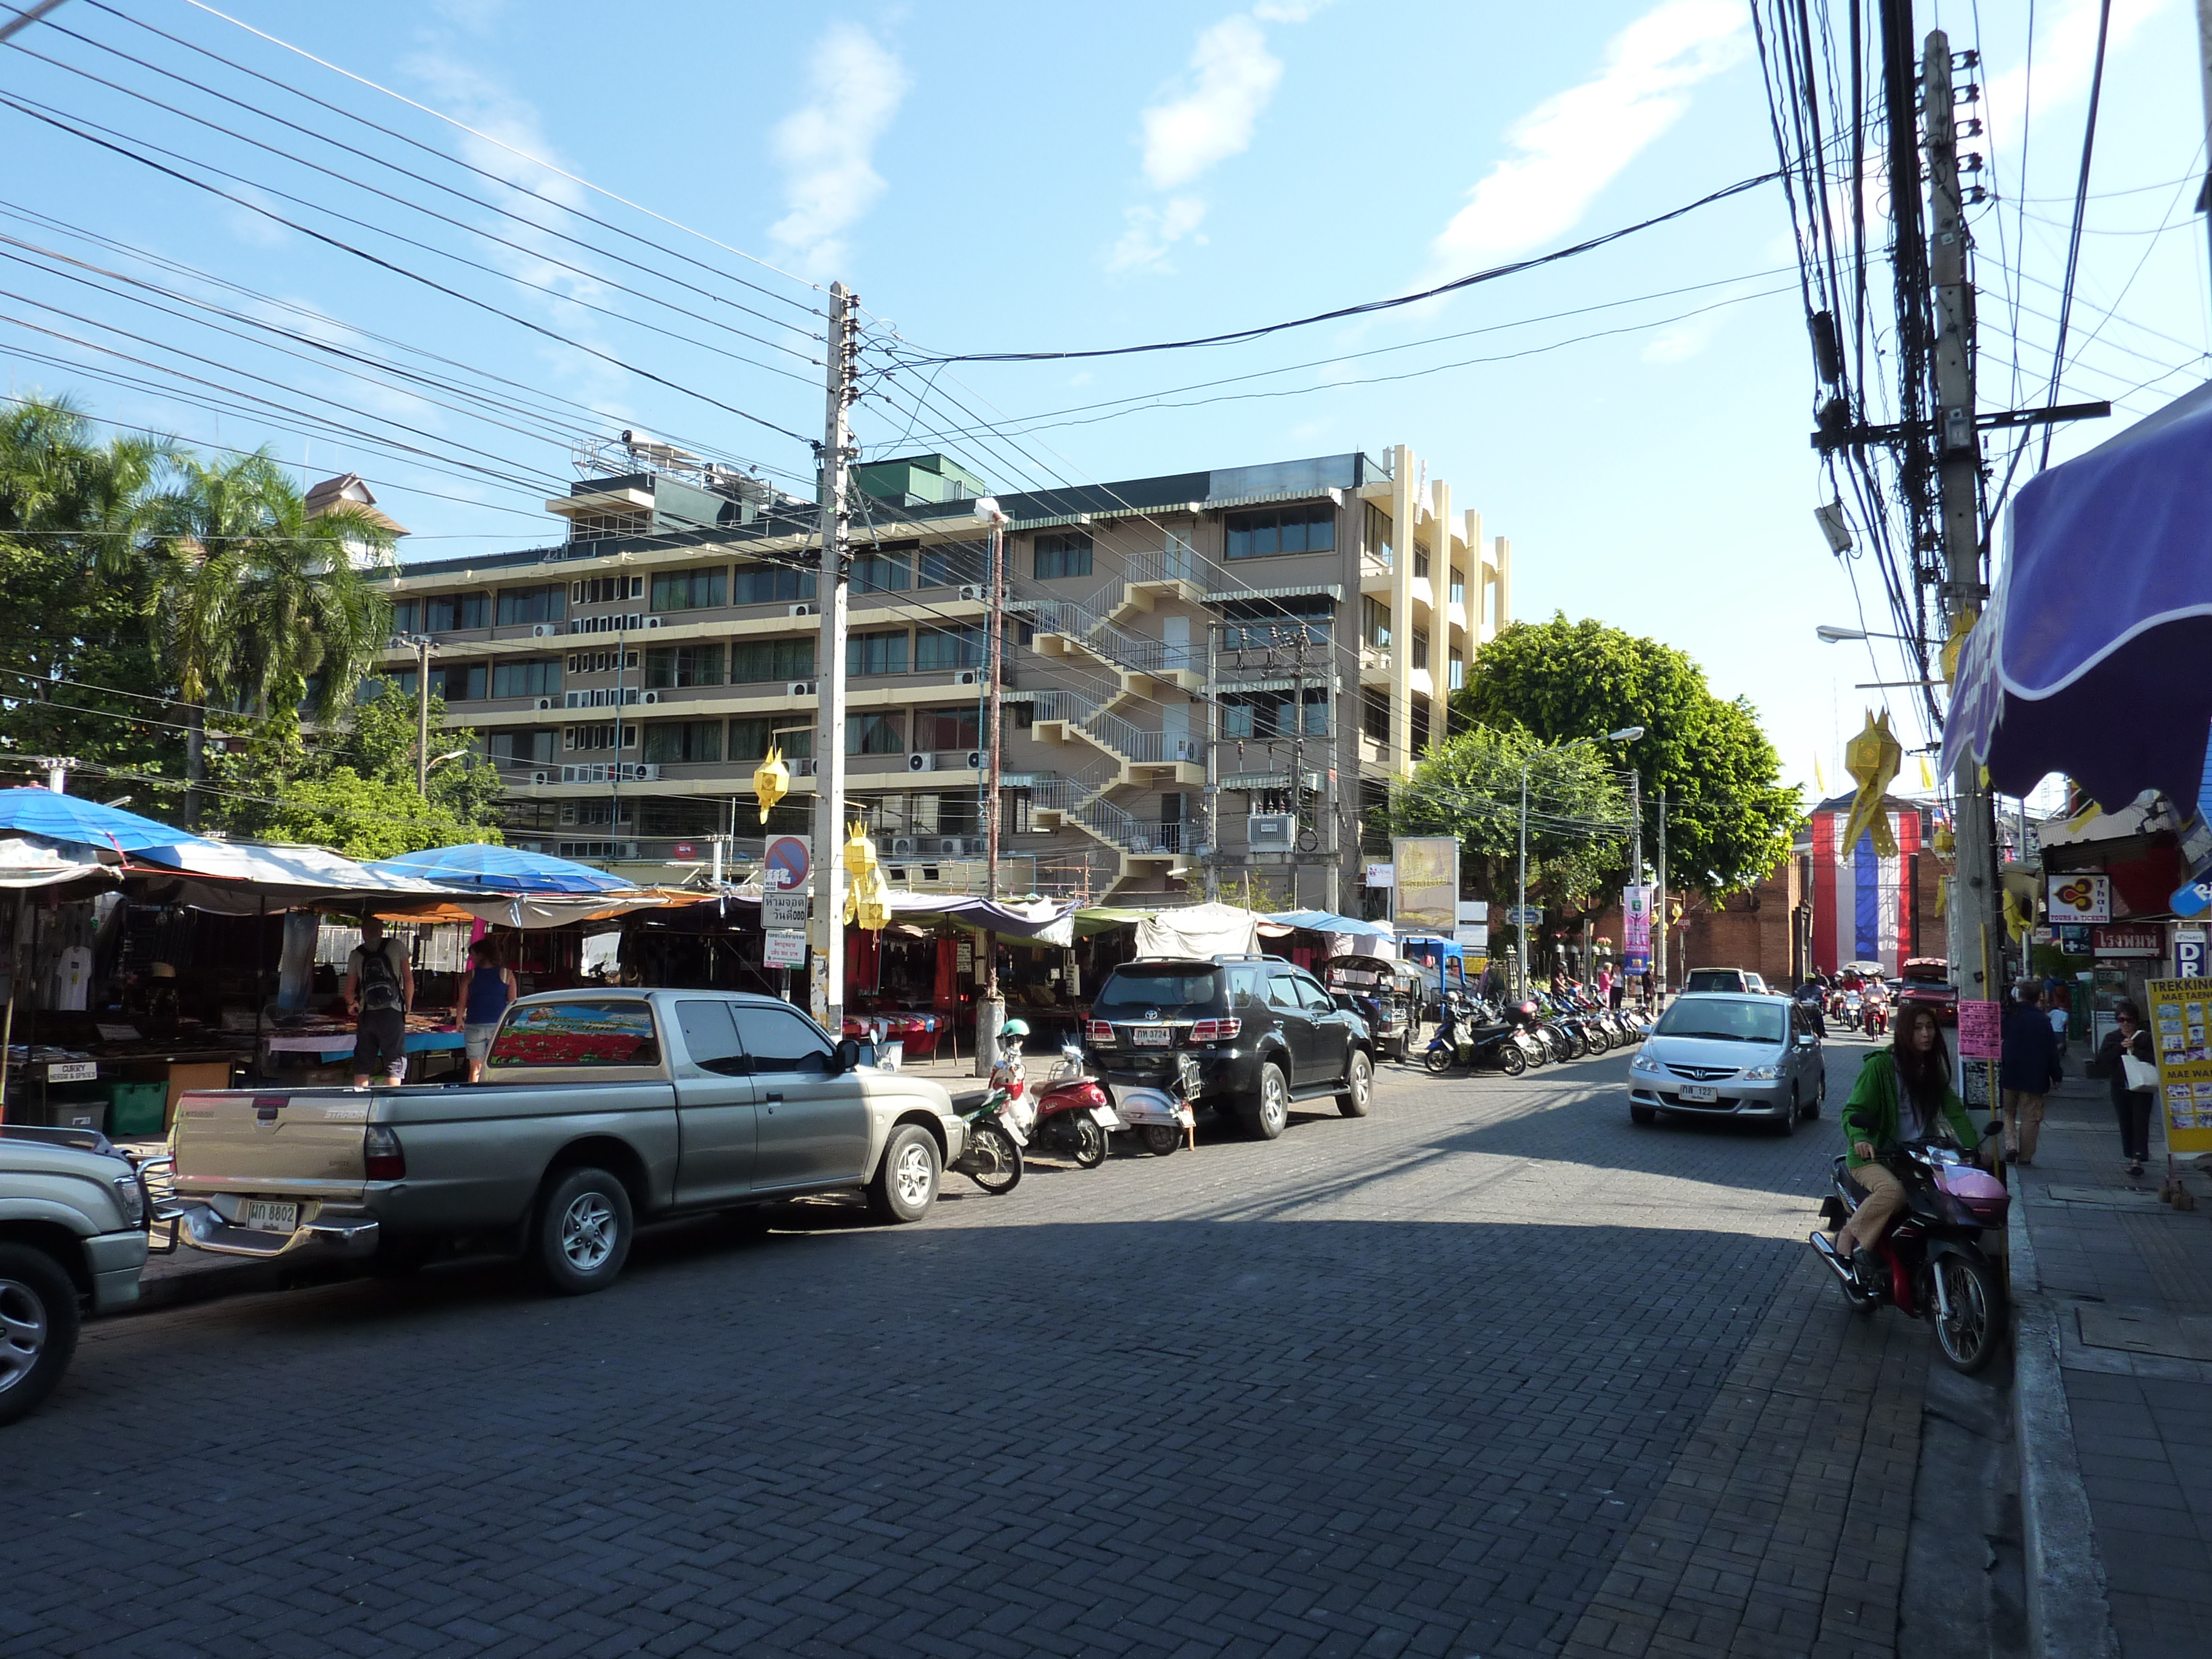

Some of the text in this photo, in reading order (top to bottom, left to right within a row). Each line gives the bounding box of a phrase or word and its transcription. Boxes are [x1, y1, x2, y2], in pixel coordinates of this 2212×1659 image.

[766, 894, 804, 907] ห้ามจอด
[2096, 925, 2157, 948] โรงพิมพ์
[324, 1110, 365, 1119] STRADA
[269, 1205, 293, 1222] 8802
